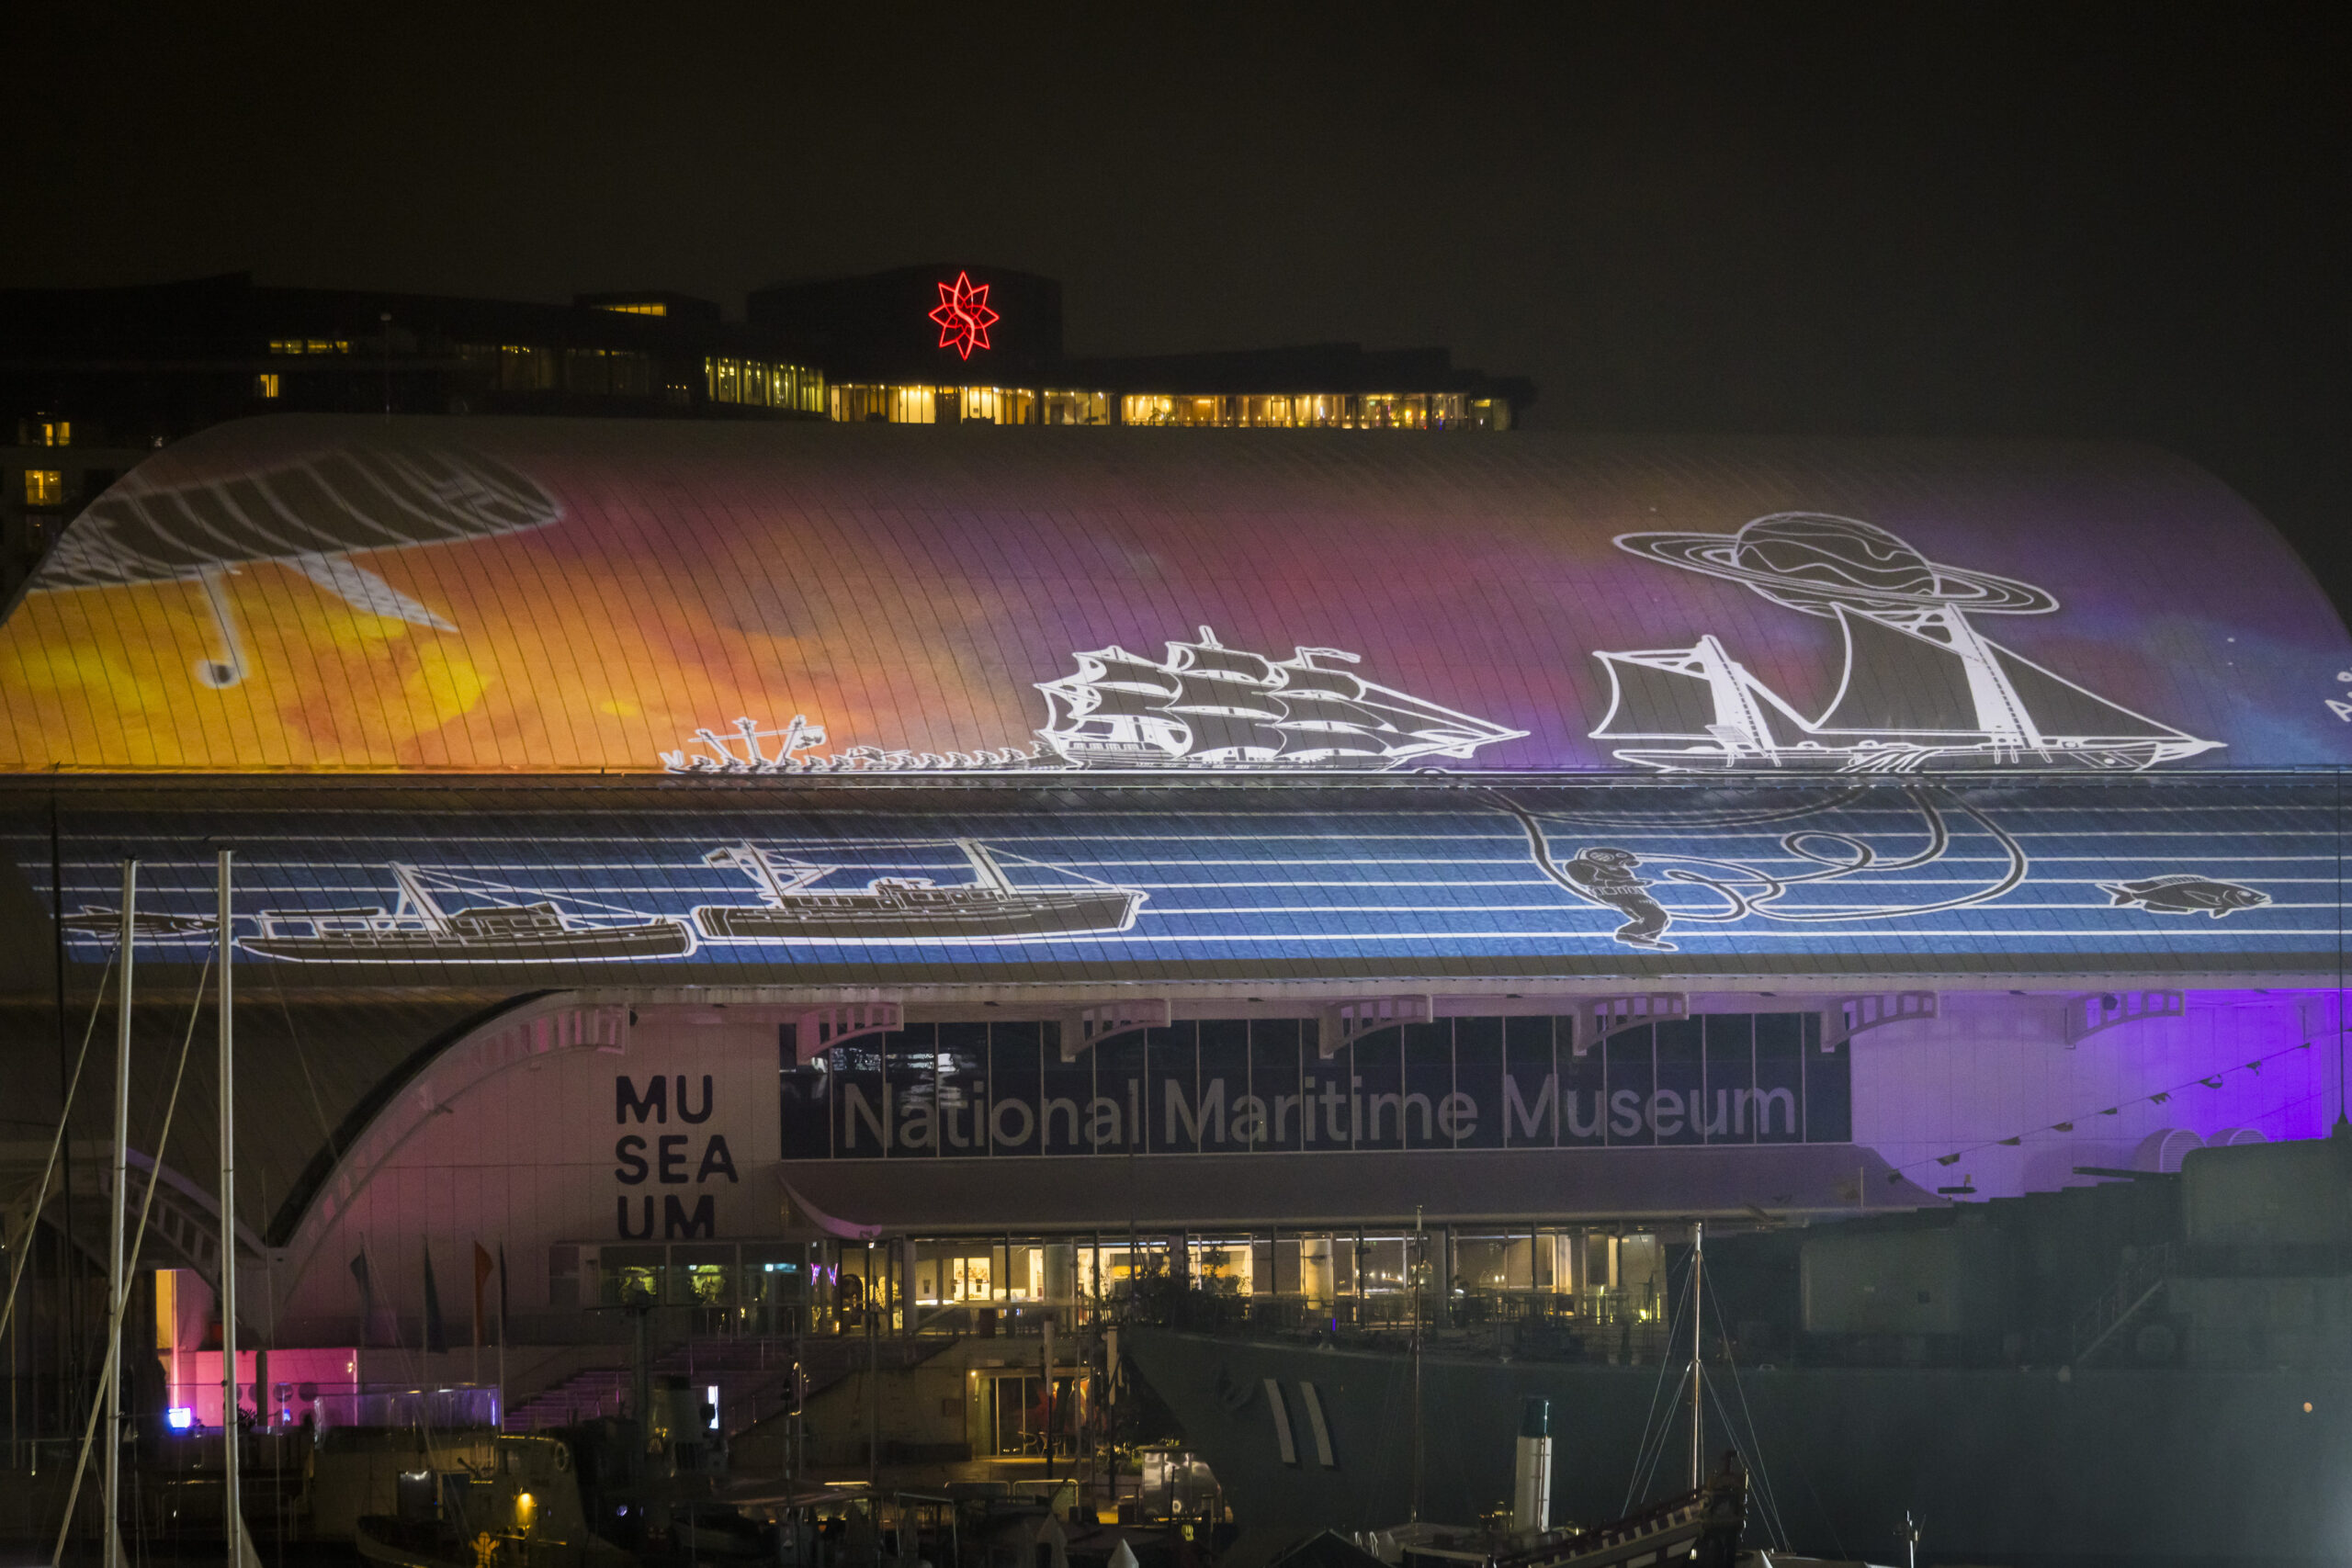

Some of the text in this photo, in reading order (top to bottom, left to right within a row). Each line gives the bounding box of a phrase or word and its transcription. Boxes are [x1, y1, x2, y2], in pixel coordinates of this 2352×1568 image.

[616, 1075, 713, 1124] MU
[844, 1073, 1796, 1148] National Maritime Museum
[615, 1134, 739, 1185] SEA
[617, 1195, 715, 1239] UM
[1263, 1379, 1334, 1466] 11
